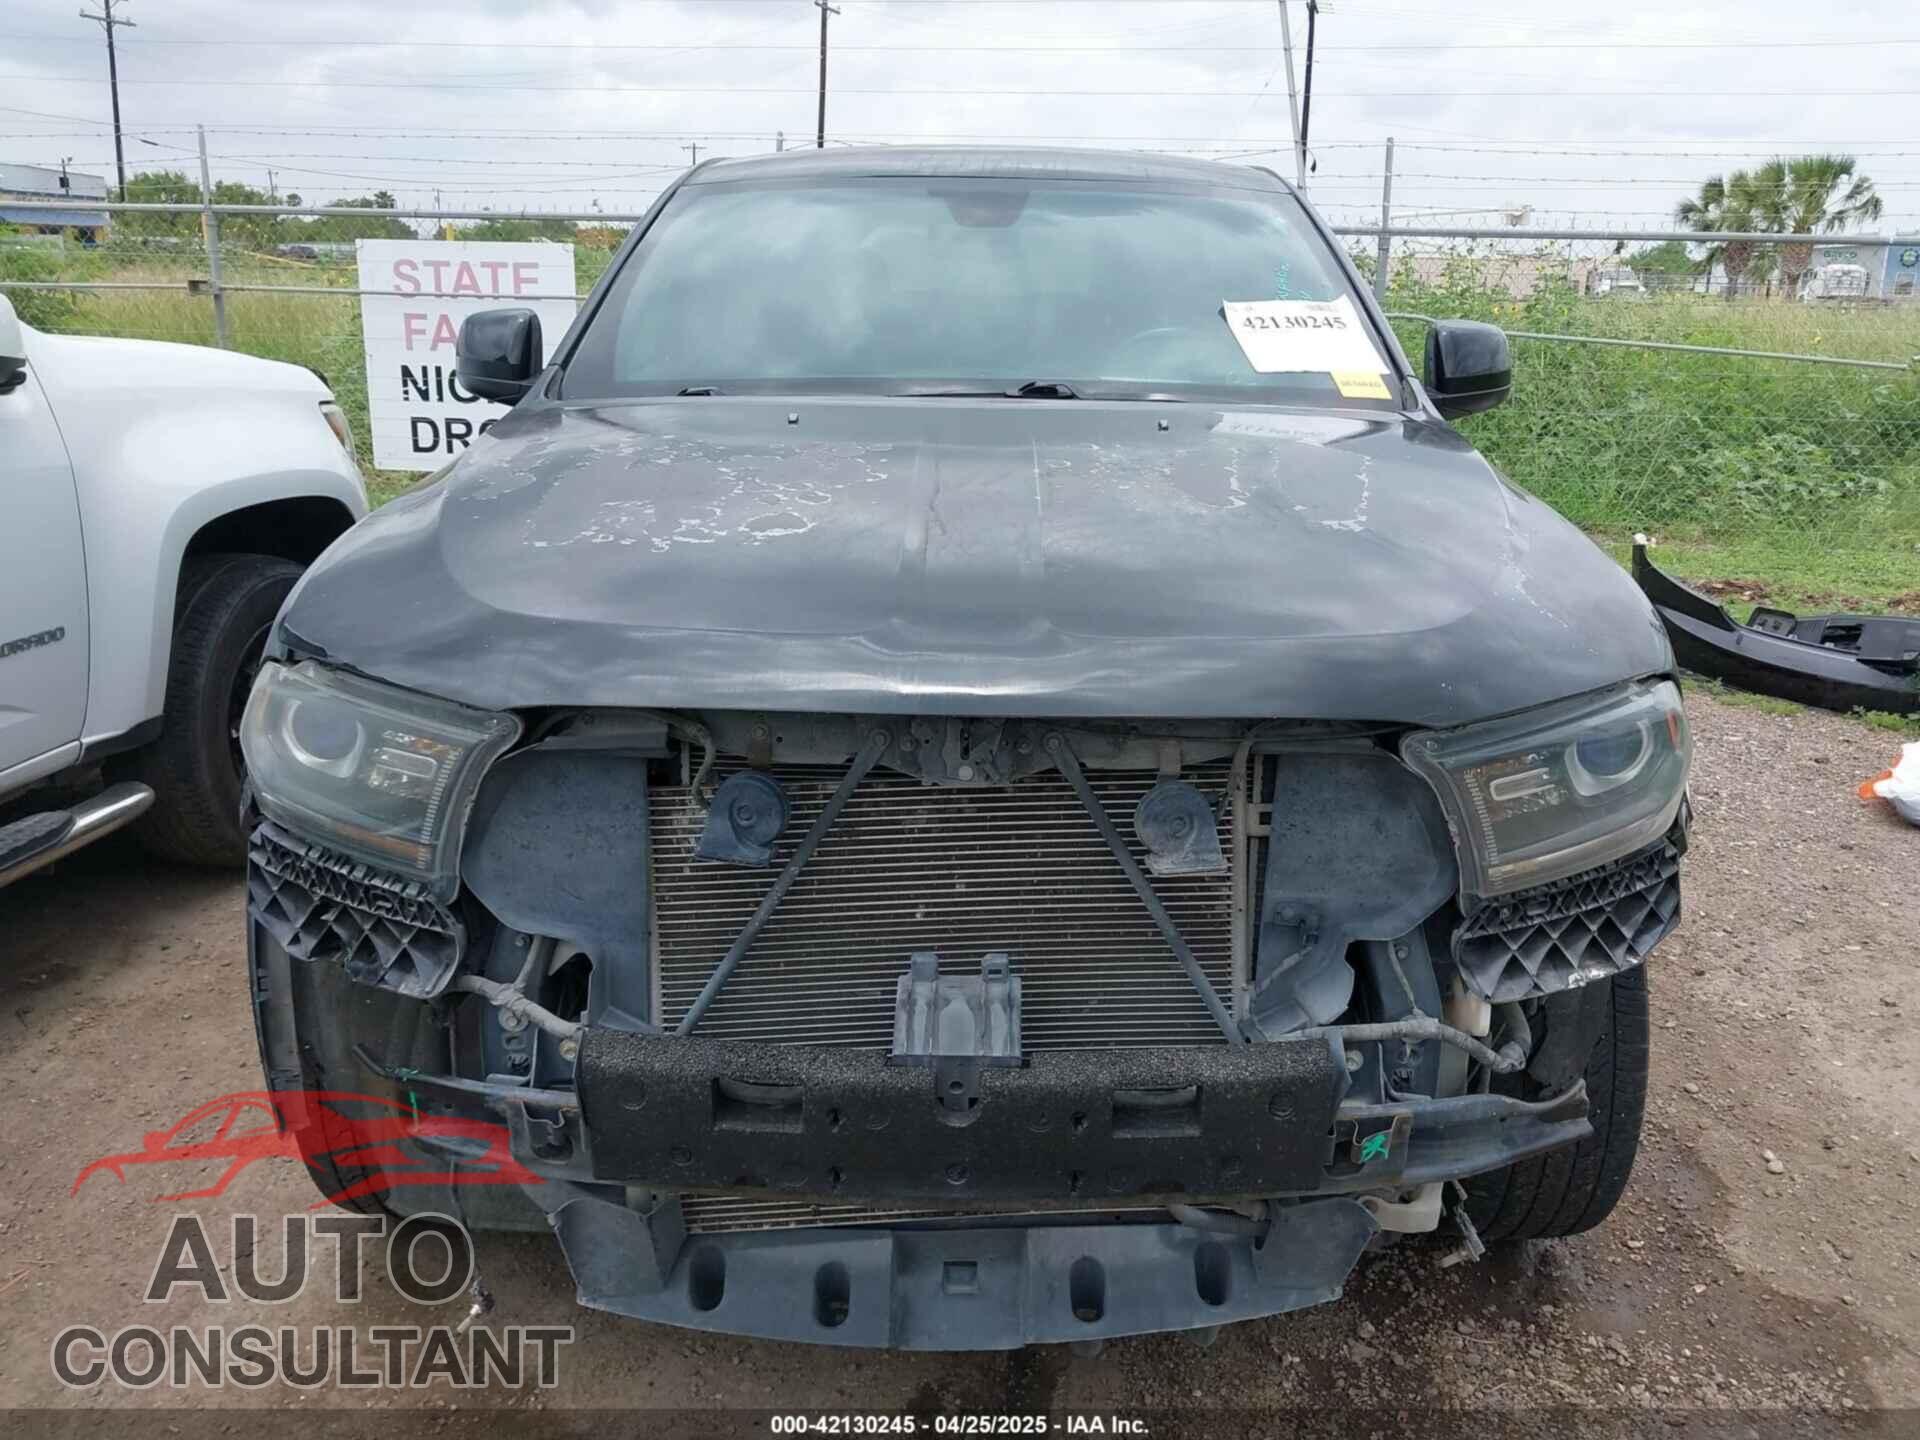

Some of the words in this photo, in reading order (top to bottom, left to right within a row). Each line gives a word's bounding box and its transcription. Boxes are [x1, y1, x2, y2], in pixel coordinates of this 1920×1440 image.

[392, 258, 540, 299] STATE
[1243, 315, 1347, 329] 42130245
[410, 416, 500, 454] DR
[0, 626, 65, 658] ORADO
